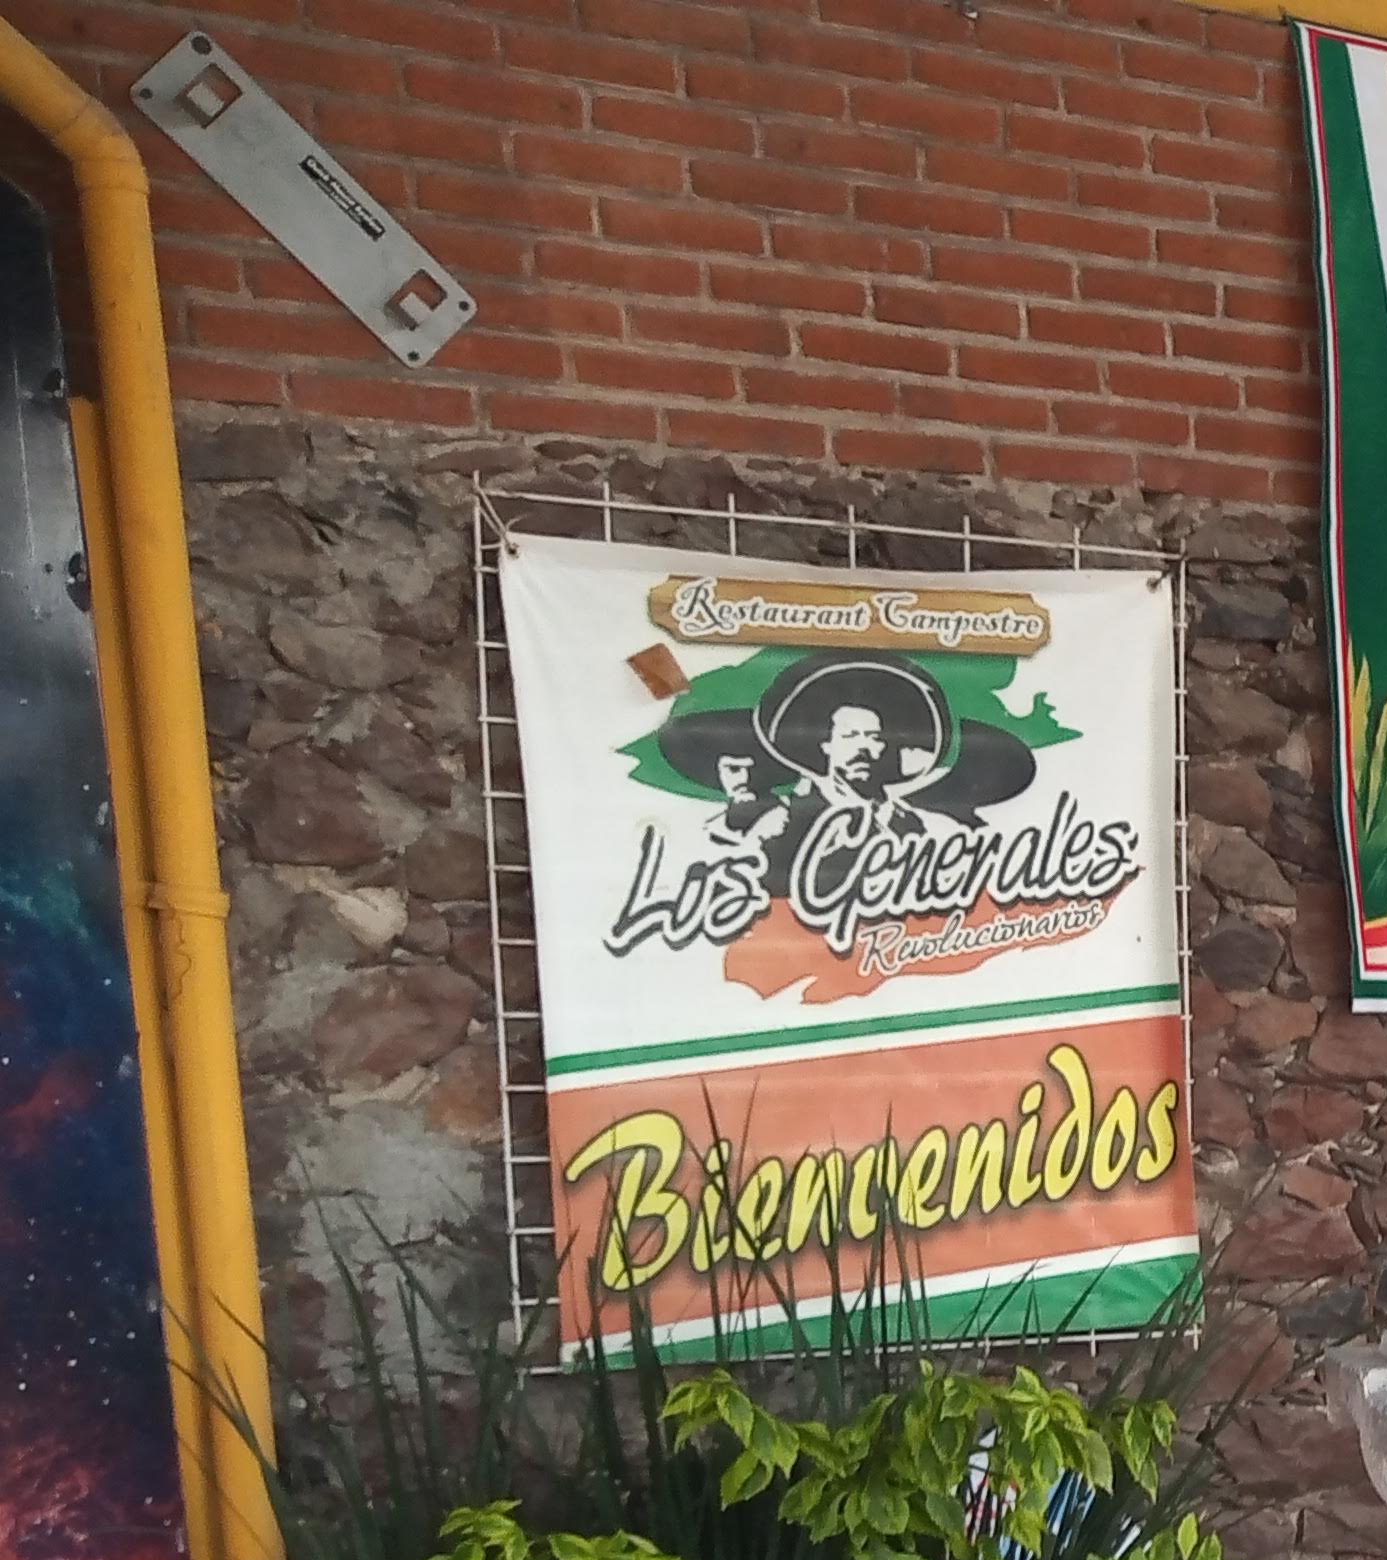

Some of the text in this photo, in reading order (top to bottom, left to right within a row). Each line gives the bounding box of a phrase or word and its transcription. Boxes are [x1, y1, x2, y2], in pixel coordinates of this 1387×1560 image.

[674, 578, 1041, 644] Restaurant Campestre
[604, 791, 1139, 956] Los Generales
[860, 902, 1102, 972] Revolucionarios
[564, 1044, 1179, 1291] Bienvenidos
